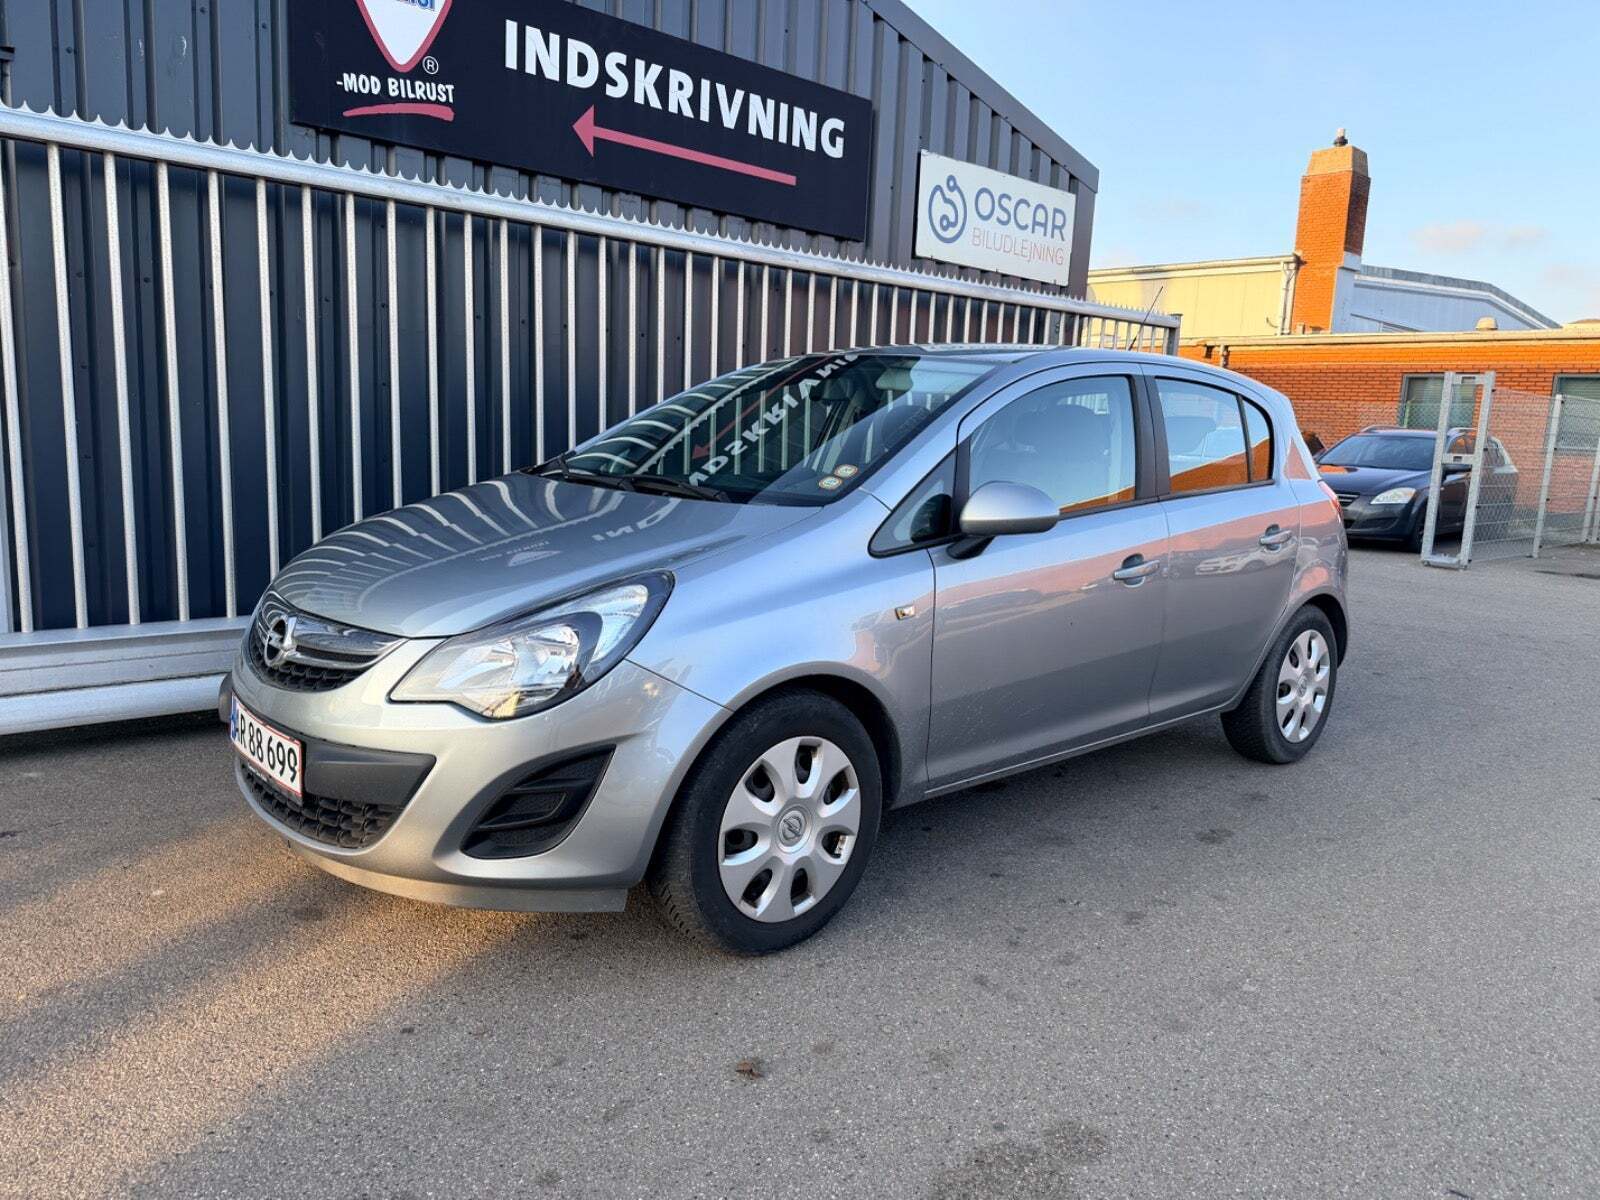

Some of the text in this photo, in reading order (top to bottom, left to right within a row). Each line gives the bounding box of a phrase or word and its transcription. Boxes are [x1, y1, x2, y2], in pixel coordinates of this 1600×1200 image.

[336, 72, 455, 103] -MOD BILRUST
[504, 19, 845, 159] INDSKRIVNING
[974, 187, 1066, 242] OSCAR
[971, 227, 1064, 266] BILUDLEJNING
[249, 721, 264, 763] 88
[267, 735, 298, 783] 699
